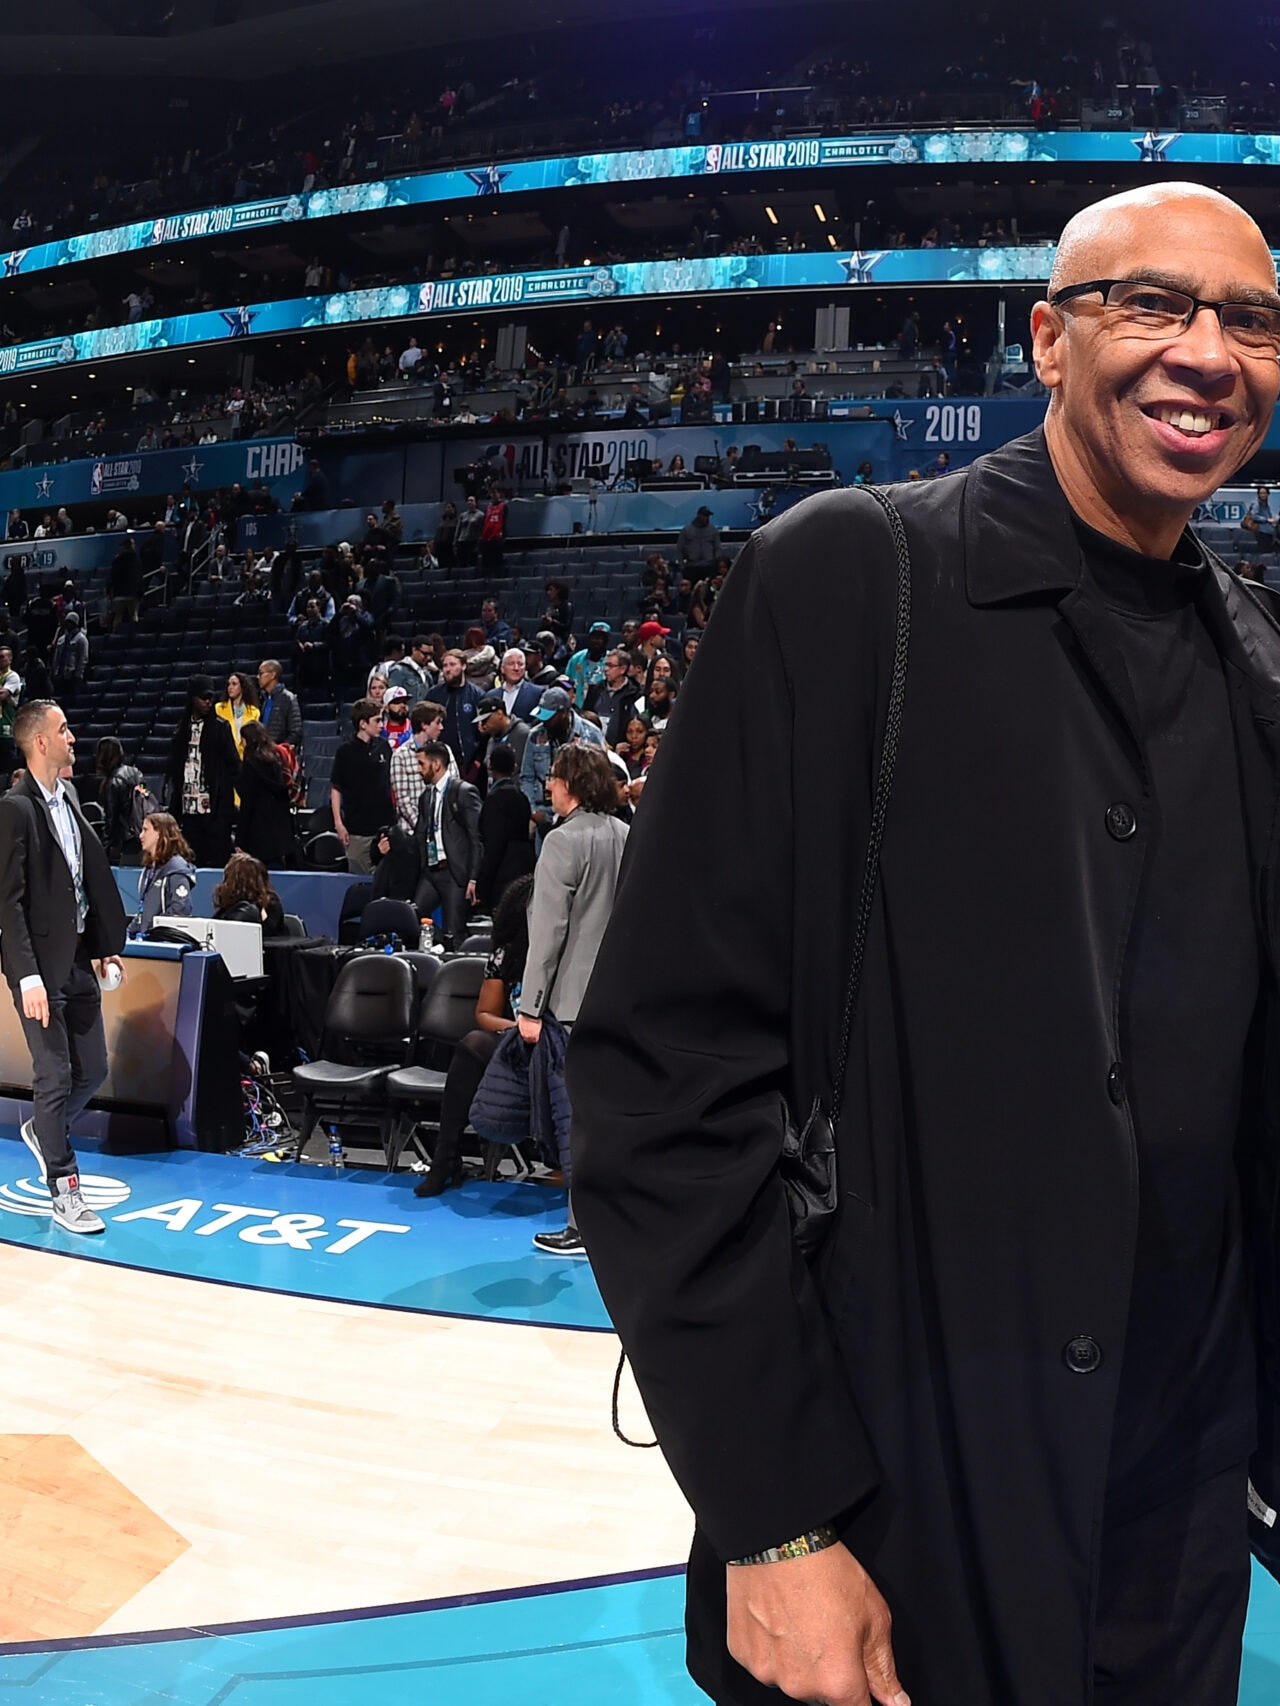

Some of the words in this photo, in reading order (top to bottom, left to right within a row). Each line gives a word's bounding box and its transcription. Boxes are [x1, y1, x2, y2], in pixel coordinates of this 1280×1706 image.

[788, 141, 820, 166] 2019
[825, 146, 885, 157] CHARLOTTE
[208, 208, 233, 233] 2019
[236, 207, 279, 221] CHARLOTTE
[493, 275, 523, 303] 2019
[528, 278, 584, 292] CHARLOTTE
[20, 347, 55, 361] CHARLOTTE
[926, 405, 981, 442] 2019
[1224, 505, 1240, 519] 19
[112, 1198, 411, 1255] AT&T
